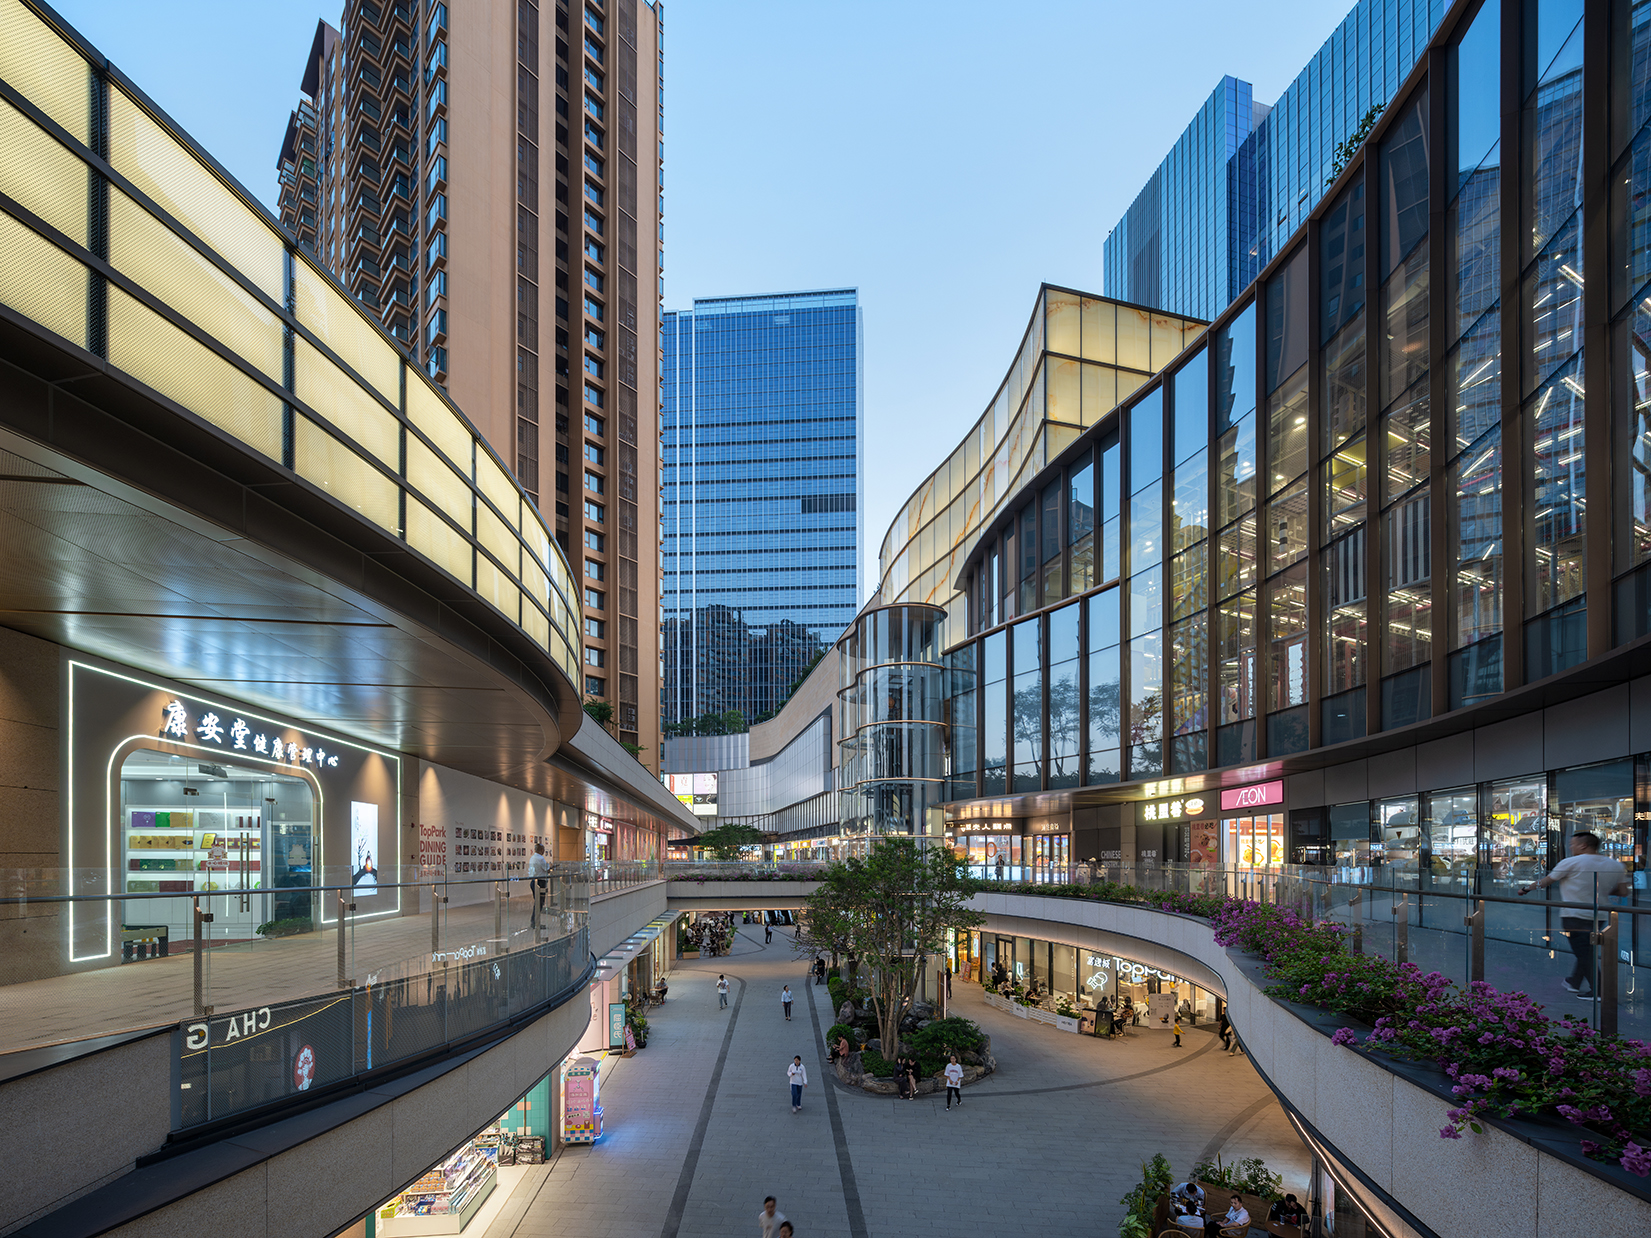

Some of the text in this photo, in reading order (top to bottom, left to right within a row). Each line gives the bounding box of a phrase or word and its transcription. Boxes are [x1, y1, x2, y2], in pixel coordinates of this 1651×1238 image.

[164, 700, 339, 768] 康安堂健康管理中心
[419, 824, 447, 839] TopPark
[420, 840, 447, 853] DINING
[420, 854, 447, 867] GUIDE
